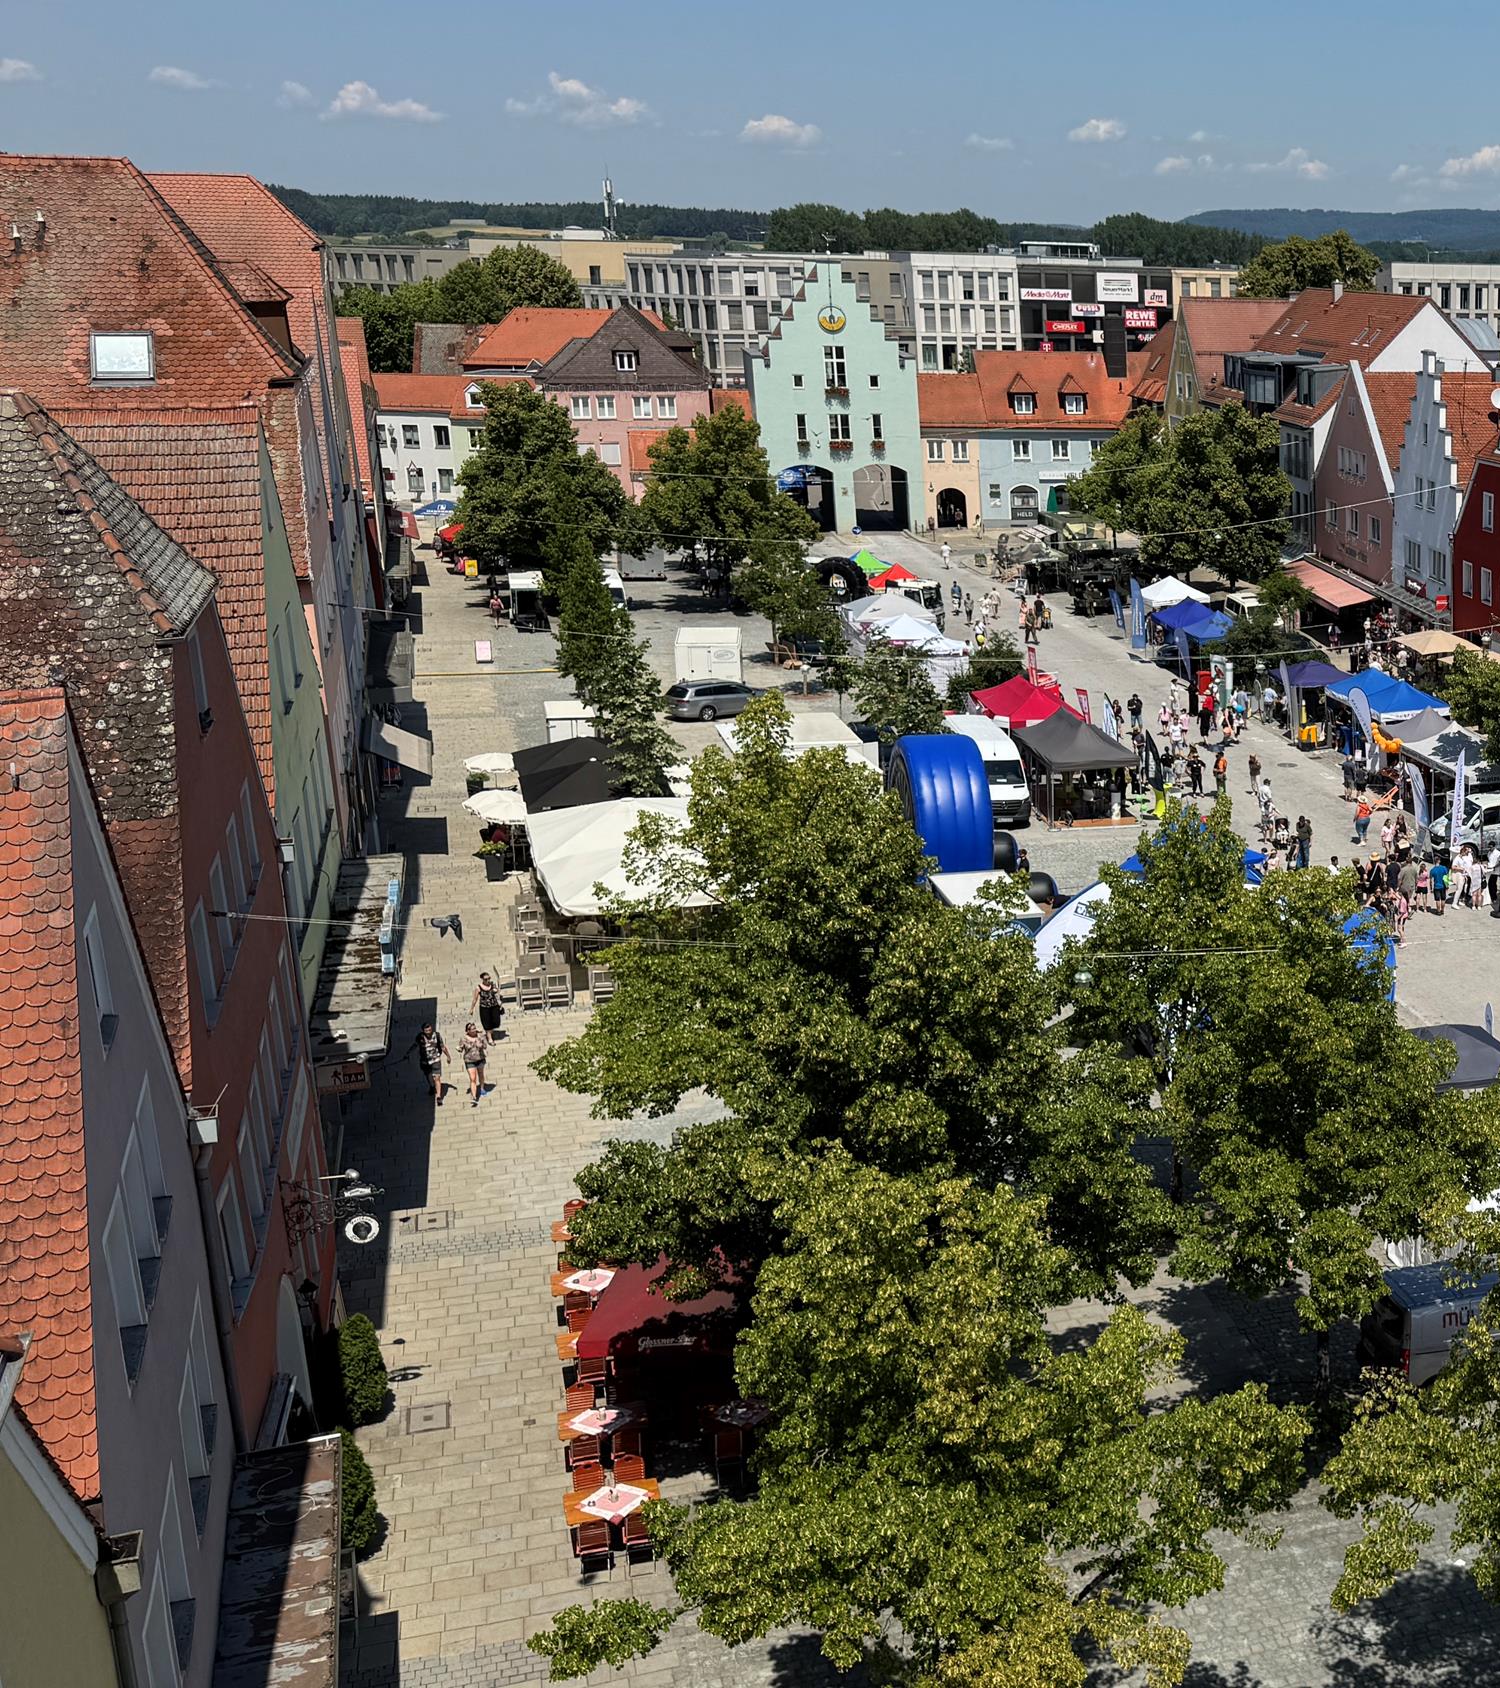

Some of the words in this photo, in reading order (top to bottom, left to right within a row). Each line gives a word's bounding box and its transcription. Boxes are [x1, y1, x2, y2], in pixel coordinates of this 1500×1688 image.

[1150, 292, 1163, 301] dm
[1125, 310, 1156, 320] REWE
[1126, 319, 1156, 327] CENTER
